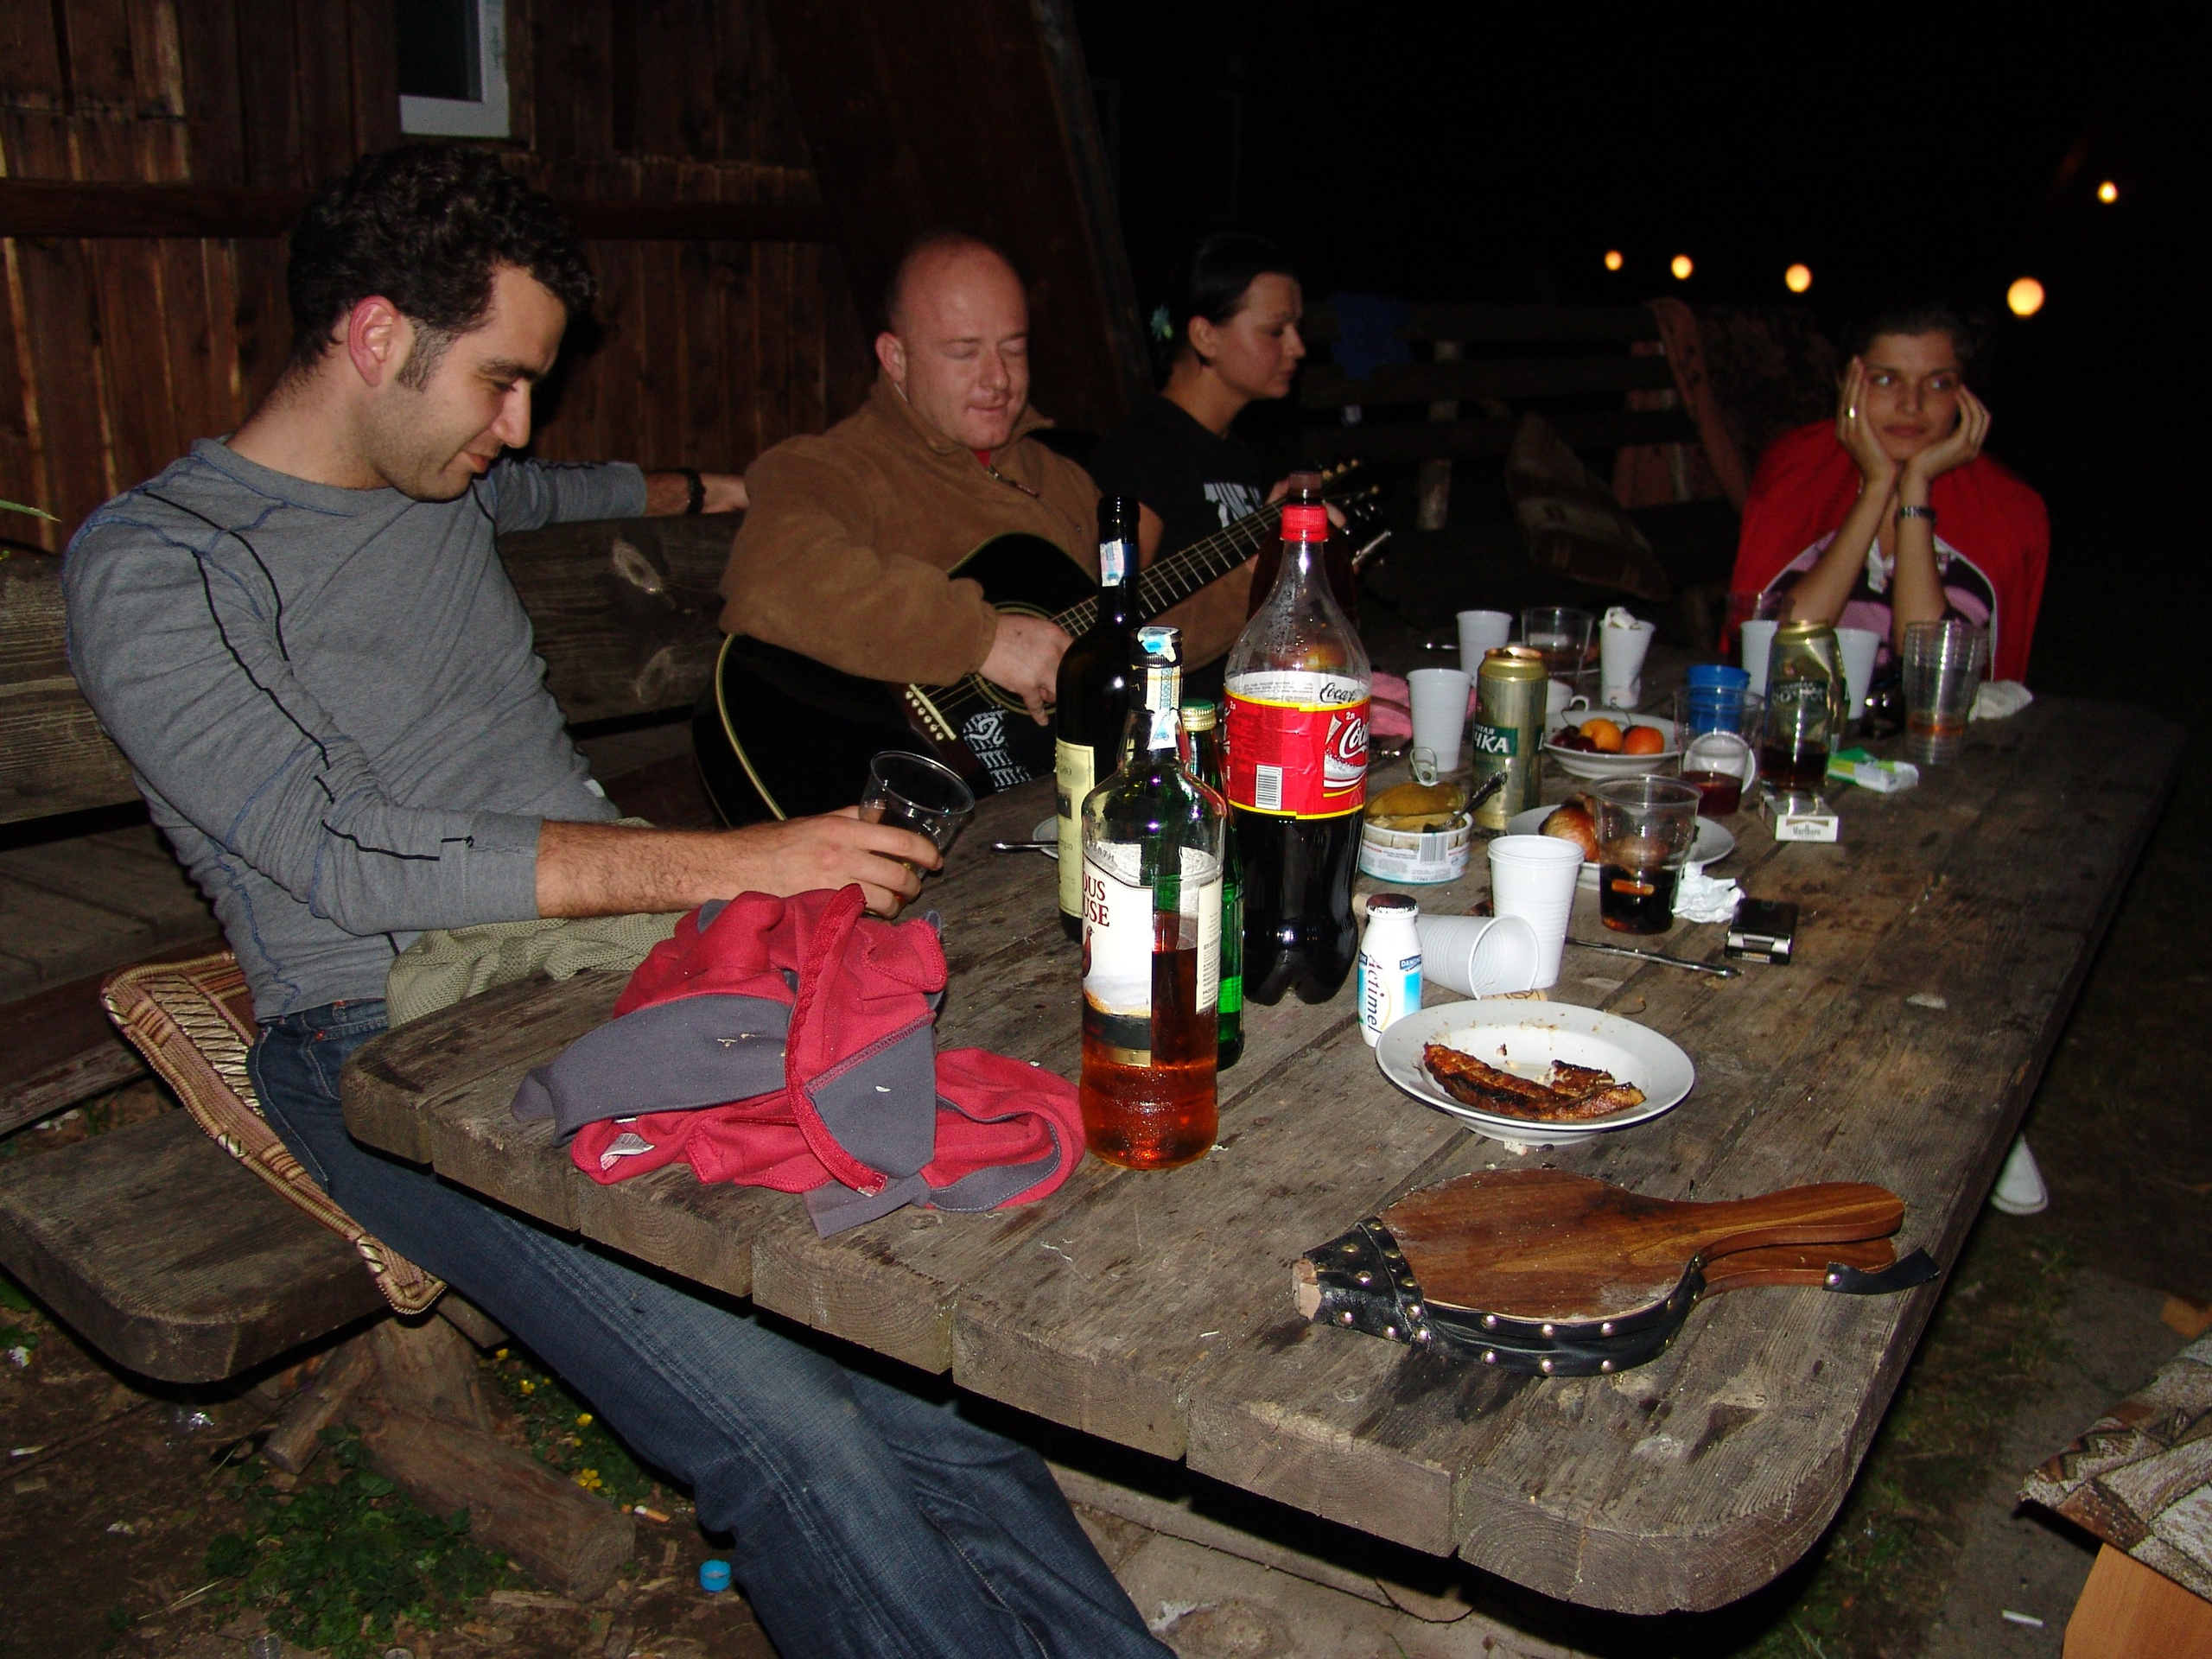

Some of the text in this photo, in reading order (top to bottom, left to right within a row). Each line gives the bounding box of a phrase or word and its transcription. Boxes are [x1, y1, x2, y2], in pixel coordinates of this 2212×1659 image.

[1345, 711, 1355, 721] 2л
[1793, 824, 1821, 836] Marlboro
[1366, 954, 1385, 1034] Actimel
